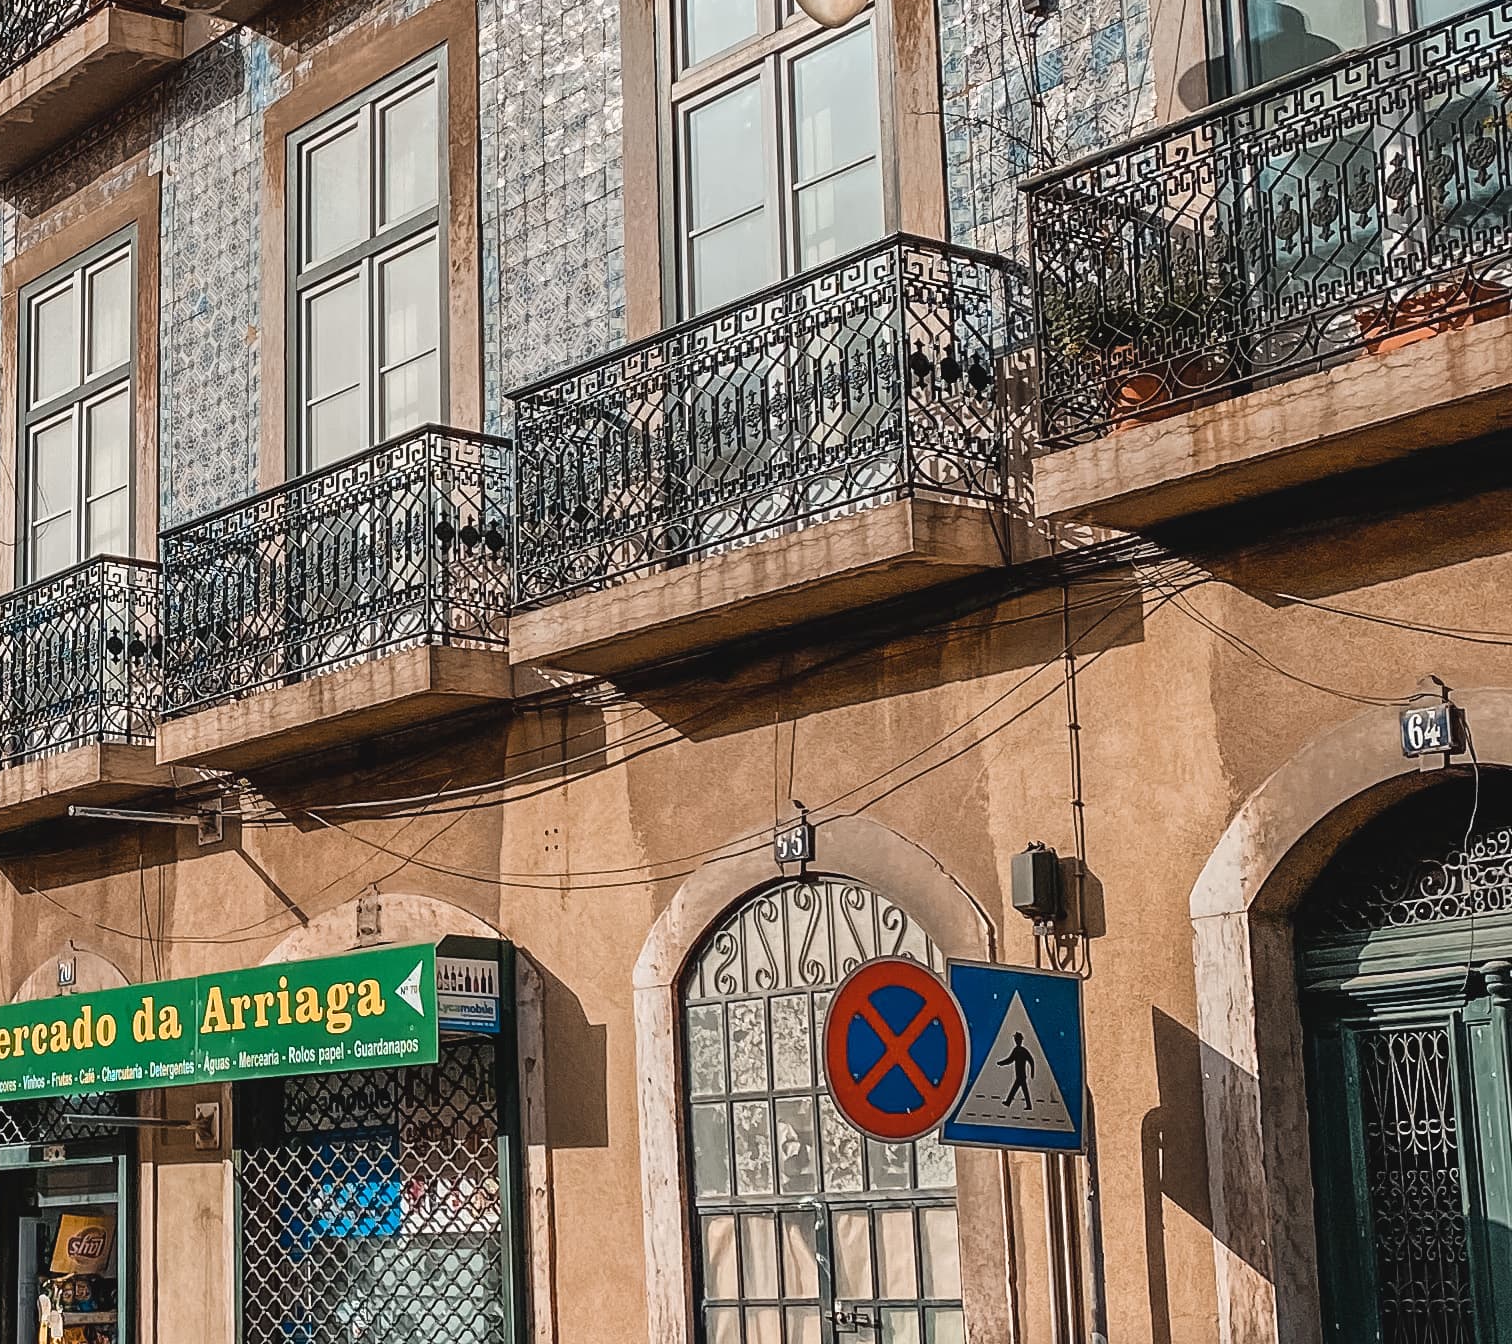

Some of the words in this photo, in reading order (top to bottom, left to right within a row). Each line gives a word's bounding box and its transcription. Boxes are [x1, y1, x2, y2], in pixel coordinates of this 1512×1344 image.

[1407, 710, 1441, 751] 64
[132, 995, 183, 1044] da
[199, 974, 386, 1035] Arriaga
[22, 1074, 46, 1091] Vinhos
[51, 1072, 73, 1088] Frutas
[79, 1067, 96, 1085] Café
[101, 1063, 143, 1083] Charcutaria
[149, 1058, 195, 1080] Detergentes
[203, 1050, 231, 1076] Águas
[238, 1048, 280, 1069] Mercearia
[288, 1045, 316, 1064] Rolos
[318, 1041, 345, 1065] papel
[353, 1038, 419, 1058] Guardanapos
